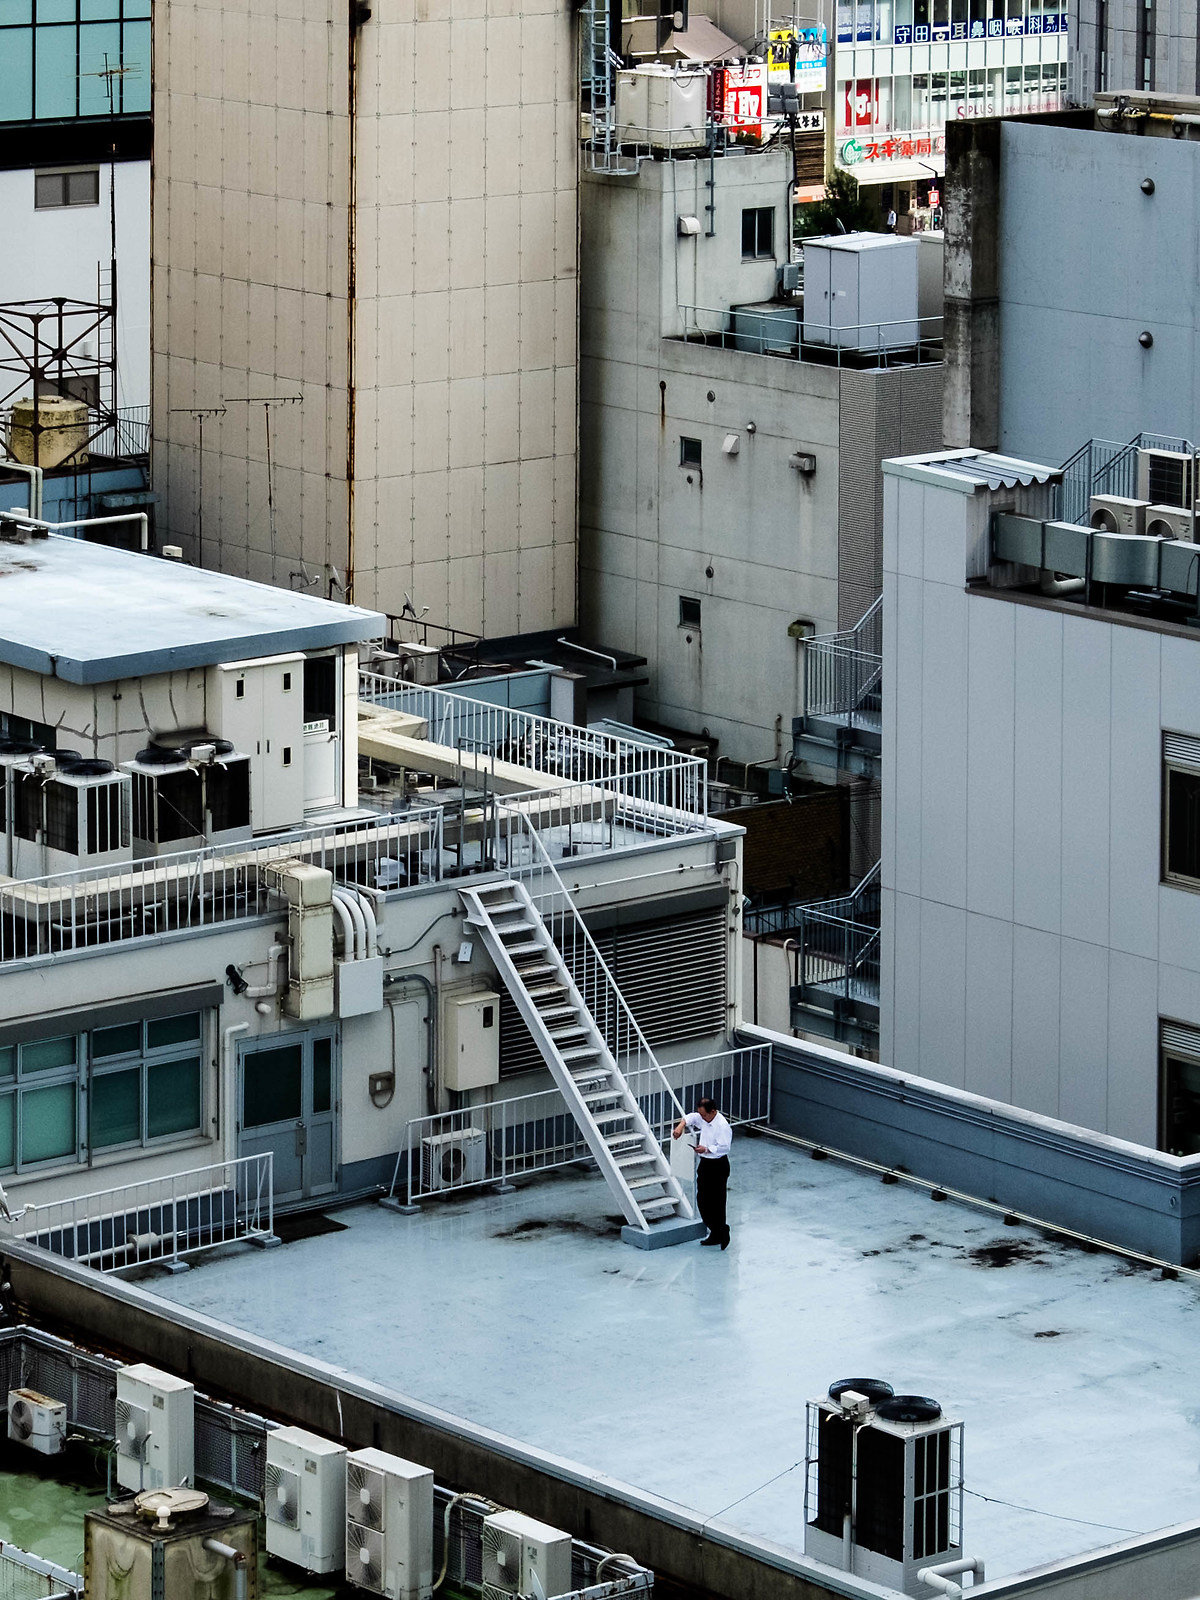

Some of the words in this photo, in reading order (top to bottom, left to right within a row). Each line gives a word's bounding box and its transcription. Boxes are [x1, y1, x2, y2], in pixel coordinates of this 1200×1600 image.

[896, 25, 929, 44] 守田
[864, 137, 931, 160] スギ薬局
